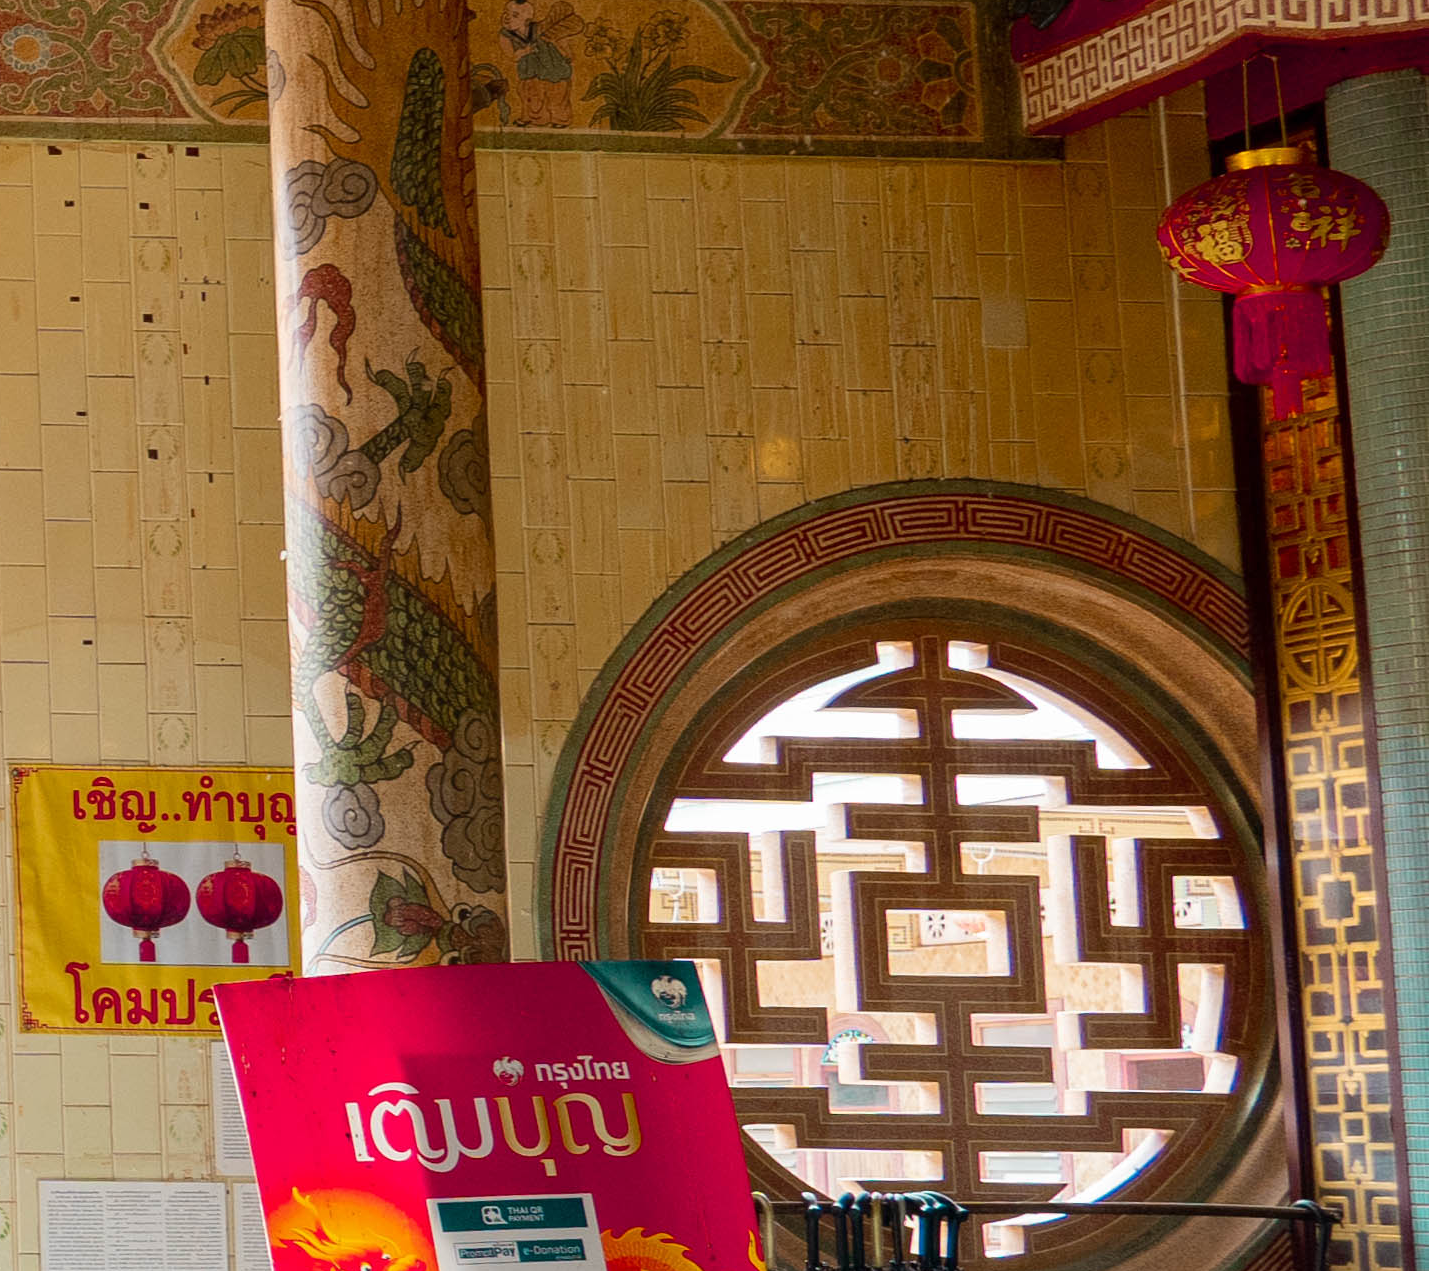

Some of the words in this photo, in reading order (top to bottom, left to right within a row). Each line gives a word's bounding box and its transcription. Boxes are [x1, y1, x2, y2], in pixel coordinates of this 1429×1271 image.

[535, 1055, 630, 1088] กรุงไทย
[345, 1081, 641, 1177] เติมบุญ
[507, 1207, 527, 1215] THAI
[508, 1214, 545, 1222] PAYMENT
[523, 1244, 581, 1256] e-Donation
